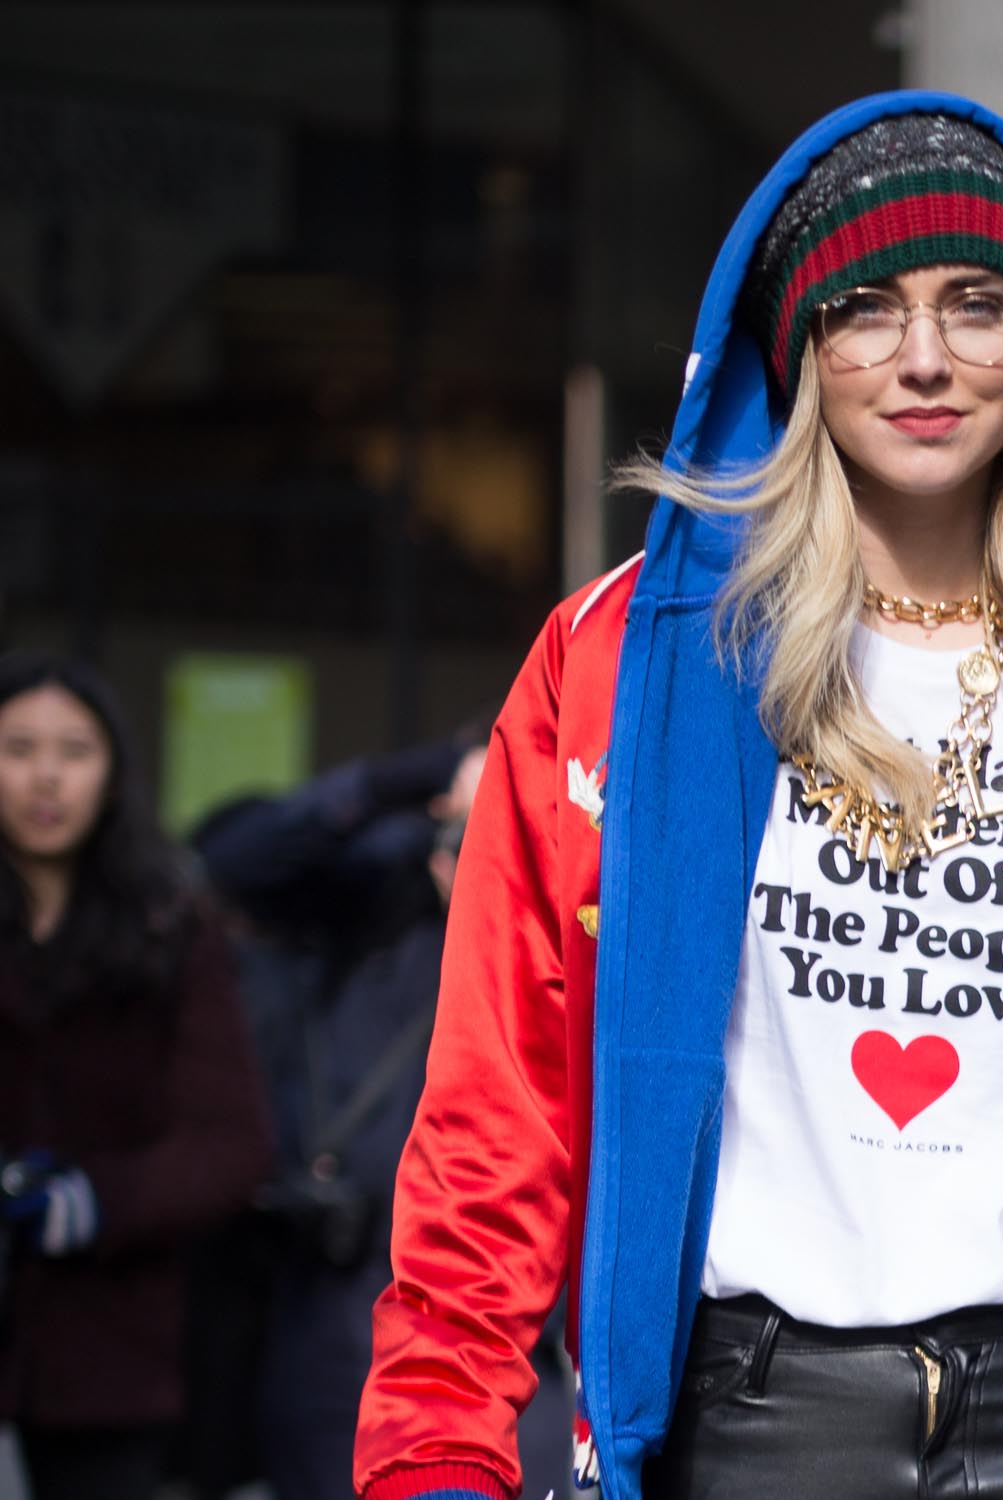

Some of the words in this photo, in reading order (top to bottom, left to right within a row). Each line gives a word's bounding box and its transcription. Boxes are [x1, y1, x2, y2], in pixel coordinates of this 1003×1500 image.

[818, 839, 930, 898] Out
[754, 883, 865, 946] The
[780, 946, 886, 1010] You
[850, 1133, 886, 1149] MARC
[894, 1142, 964, 1153] JACOBS
